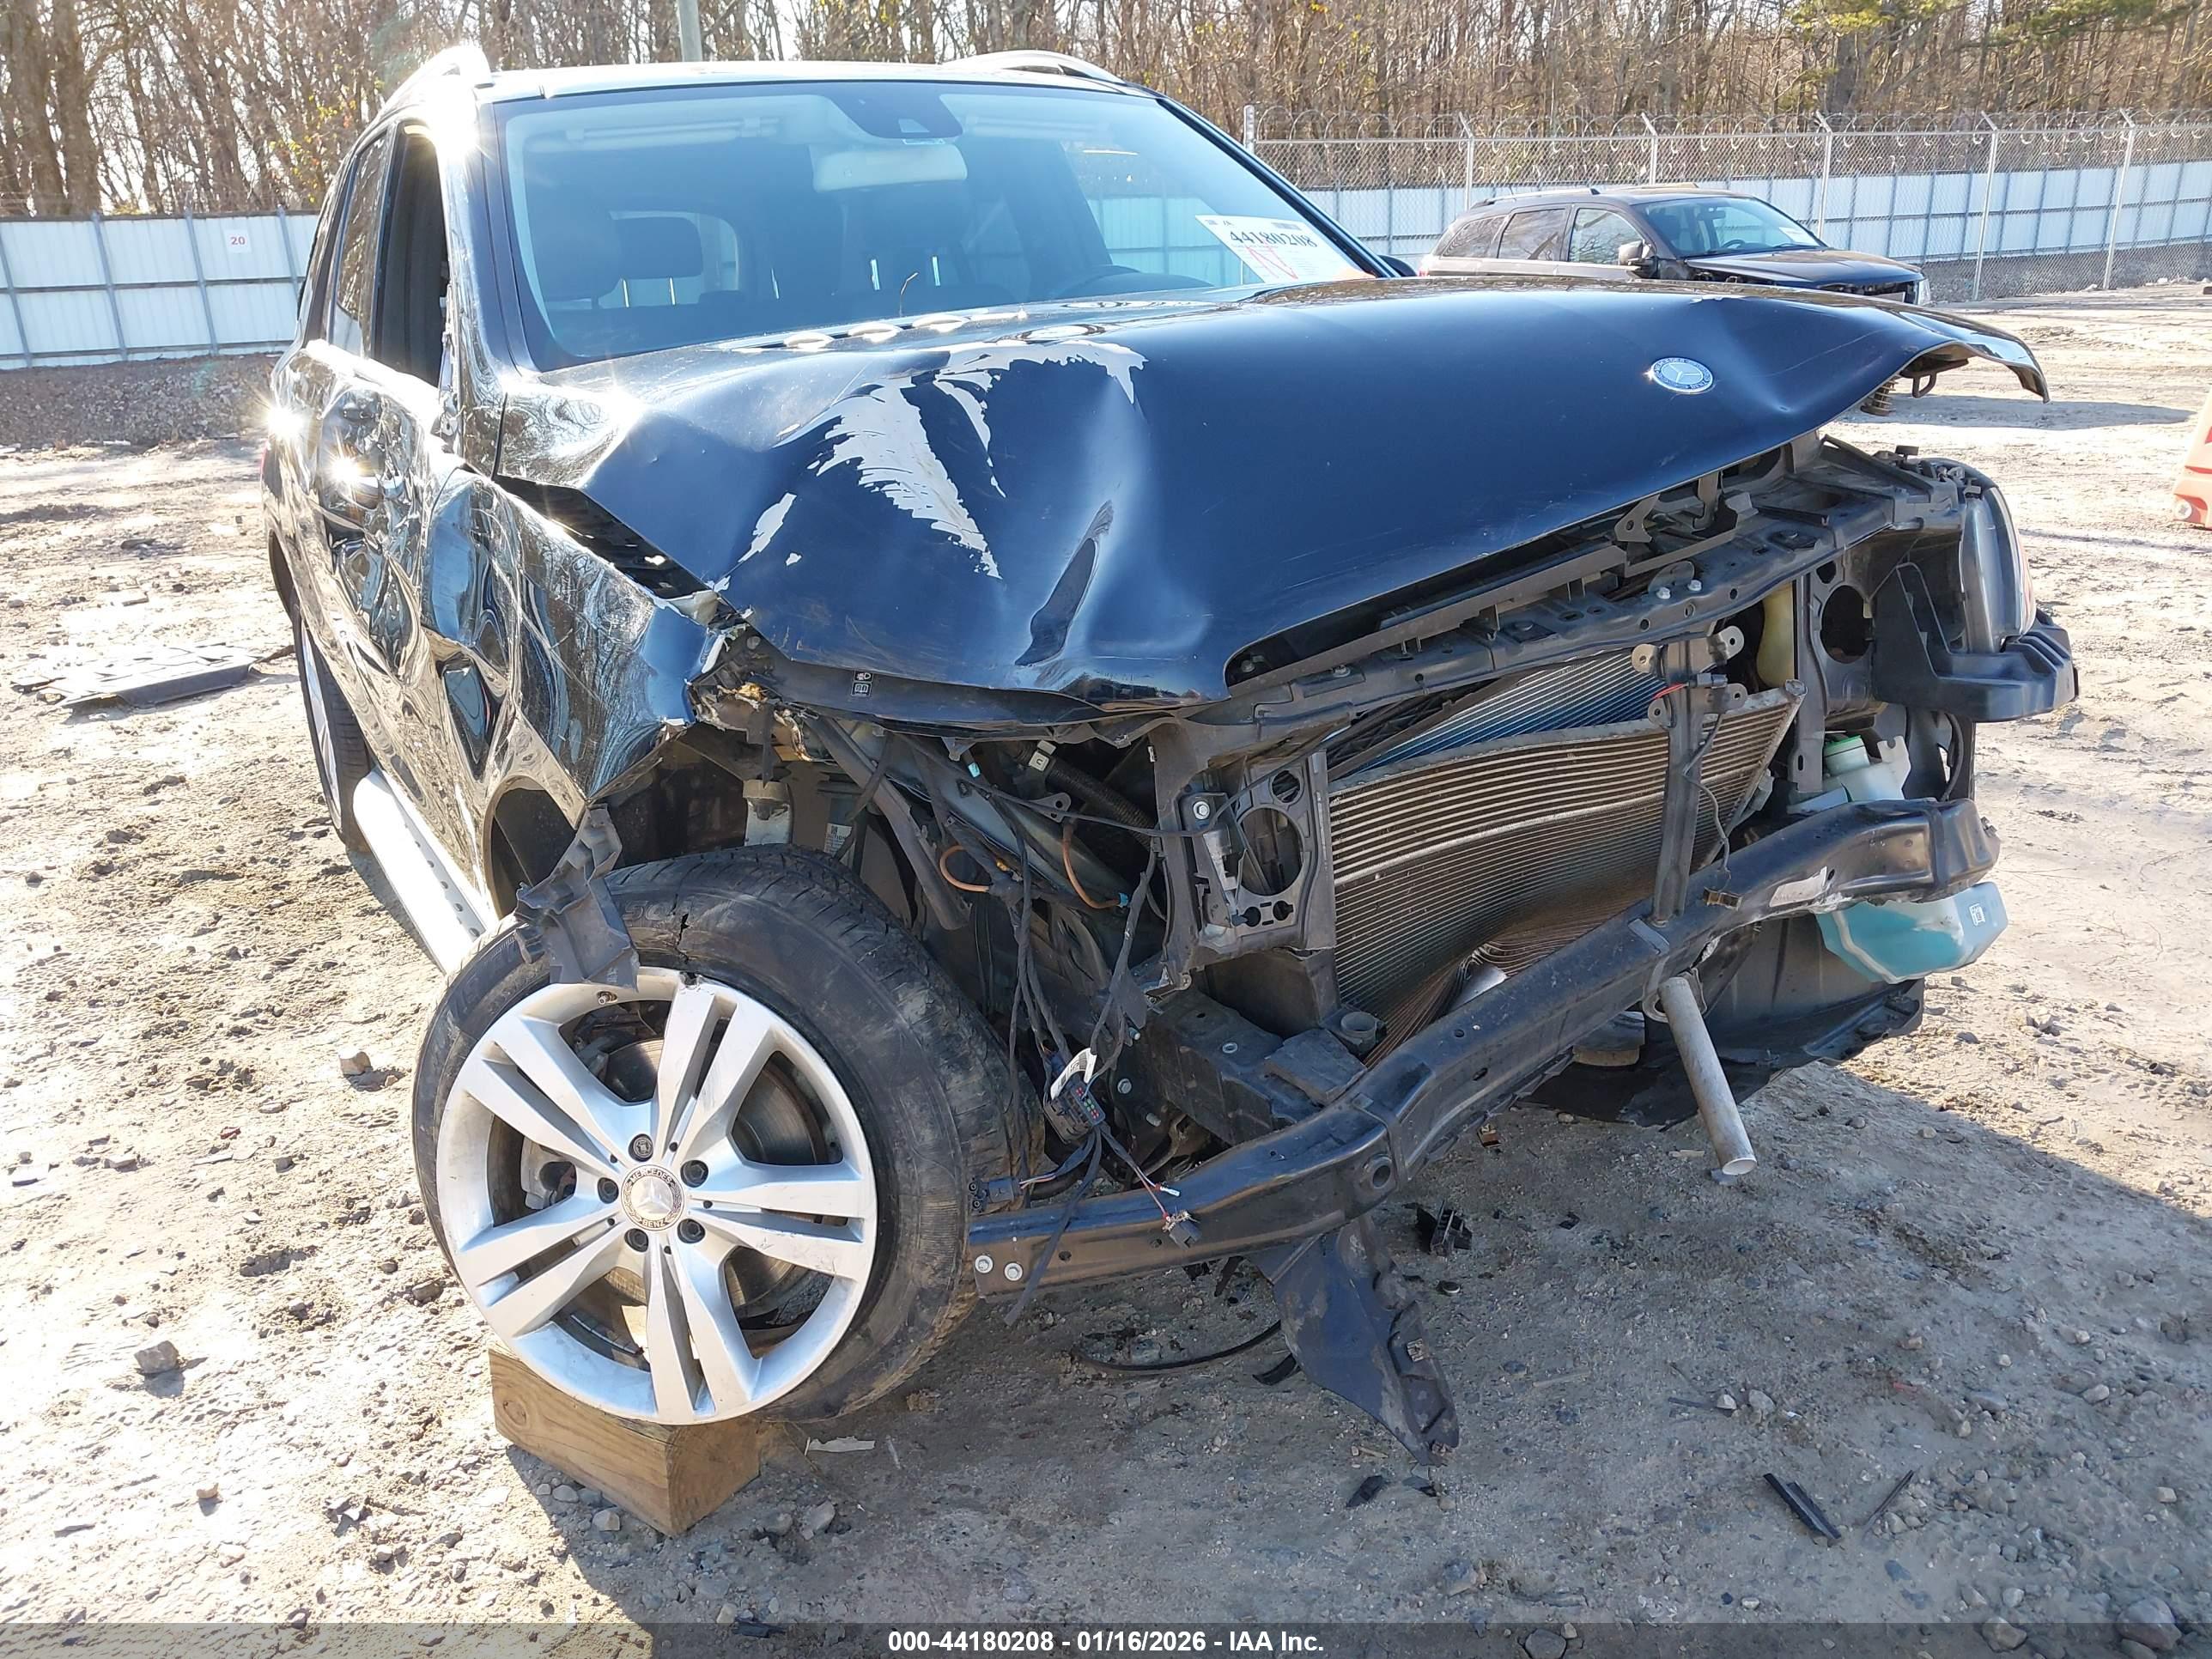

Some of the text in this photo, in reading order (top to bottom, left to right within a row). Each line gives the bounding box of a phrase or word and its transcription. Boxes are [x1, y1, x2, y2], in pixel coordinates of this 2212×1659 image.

[230, 236, 246, 246] 20
[1230, 230, 1318, 248] 44180208
[629, 1168, 672, 1184] MERCEDES
[641, 1219, 665, 1228] BENZ
